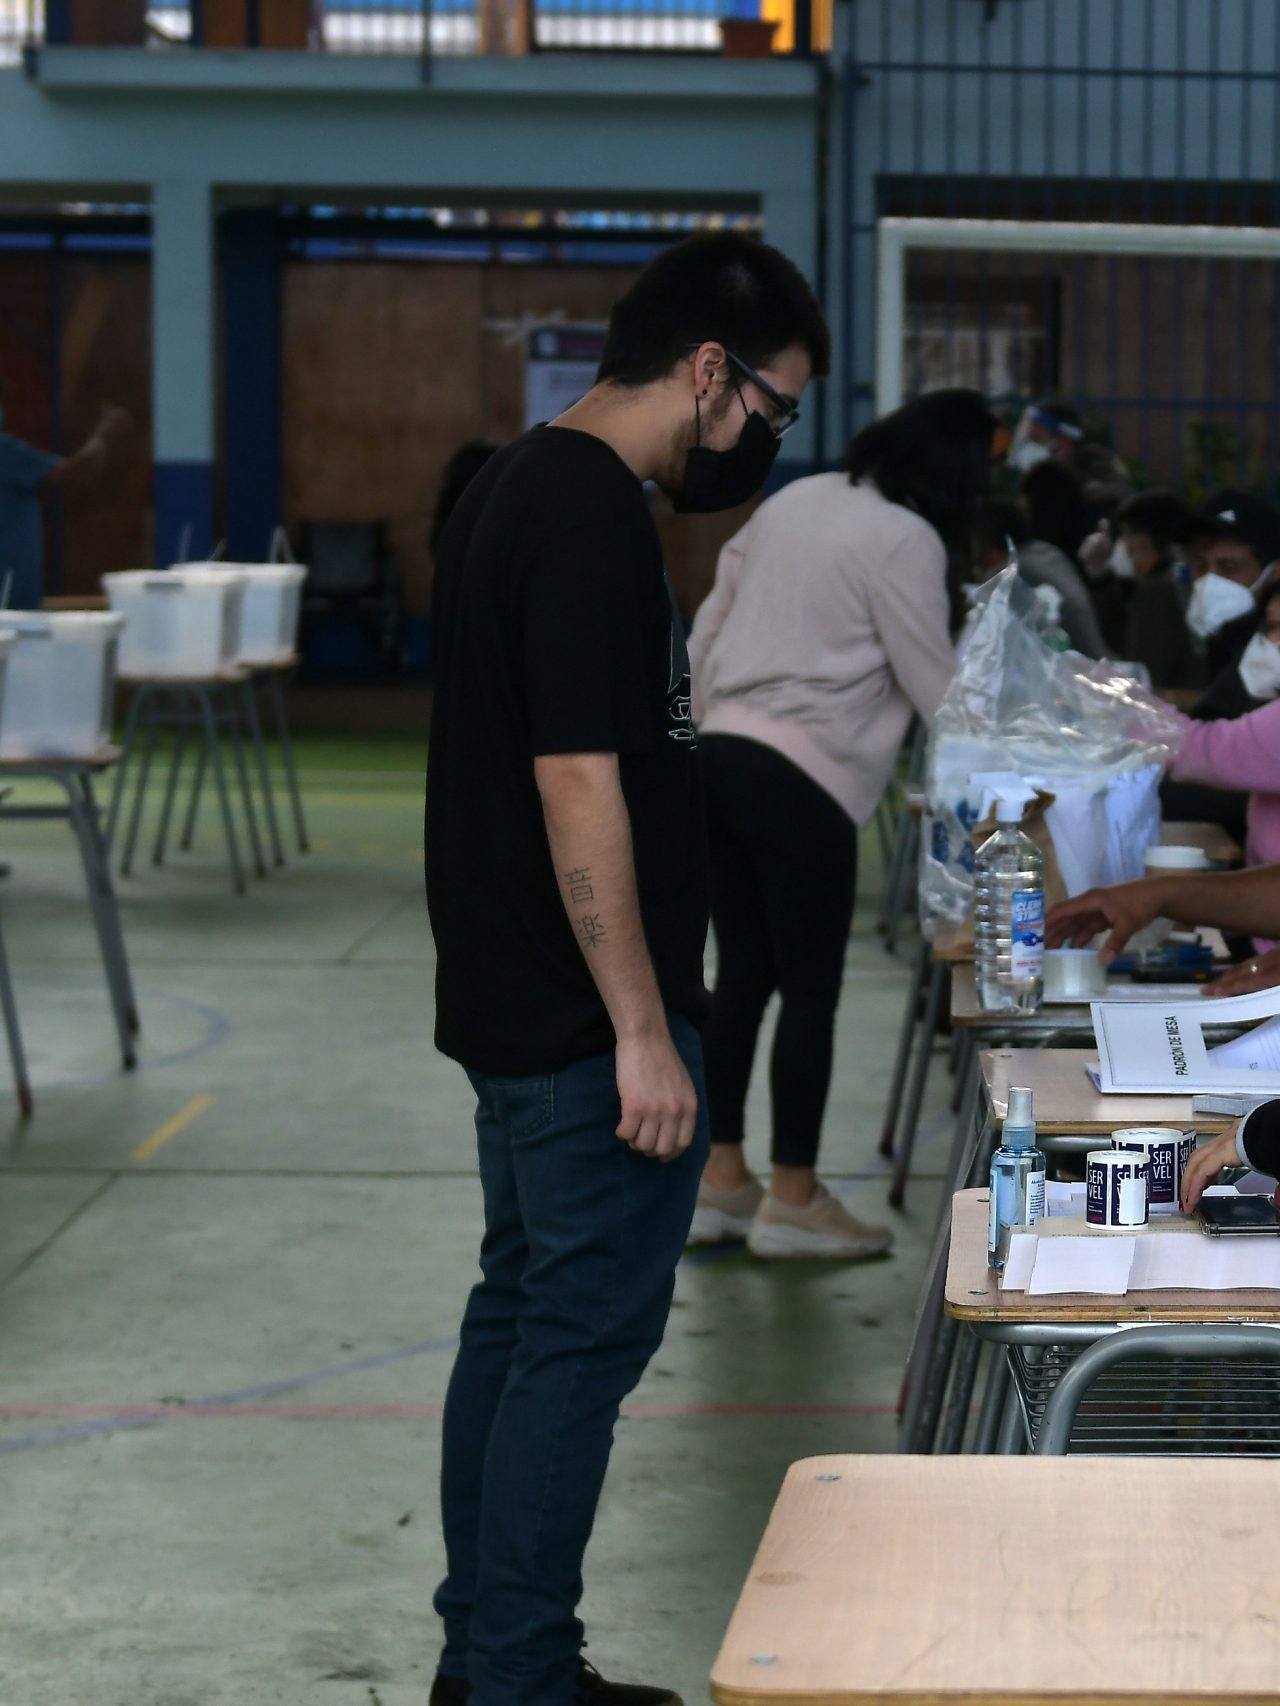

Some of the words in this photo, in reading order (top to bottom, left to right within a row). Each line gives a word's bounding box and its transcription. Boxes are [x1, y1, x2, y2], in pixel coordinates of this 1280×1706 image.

[1164, 1015, 1180, 1036] MESA
[1169, 1036, 1183, 1046] DE
[1168, 1046, 1189, 1076] PADRÓN
[1152, 1150, 1172, 1165] SER
[1088, 1169, 1104, 1185] SER
[1152, 1165, 1172, 1180] VEL
[1088, 1185, 1104, 1200] VEL
